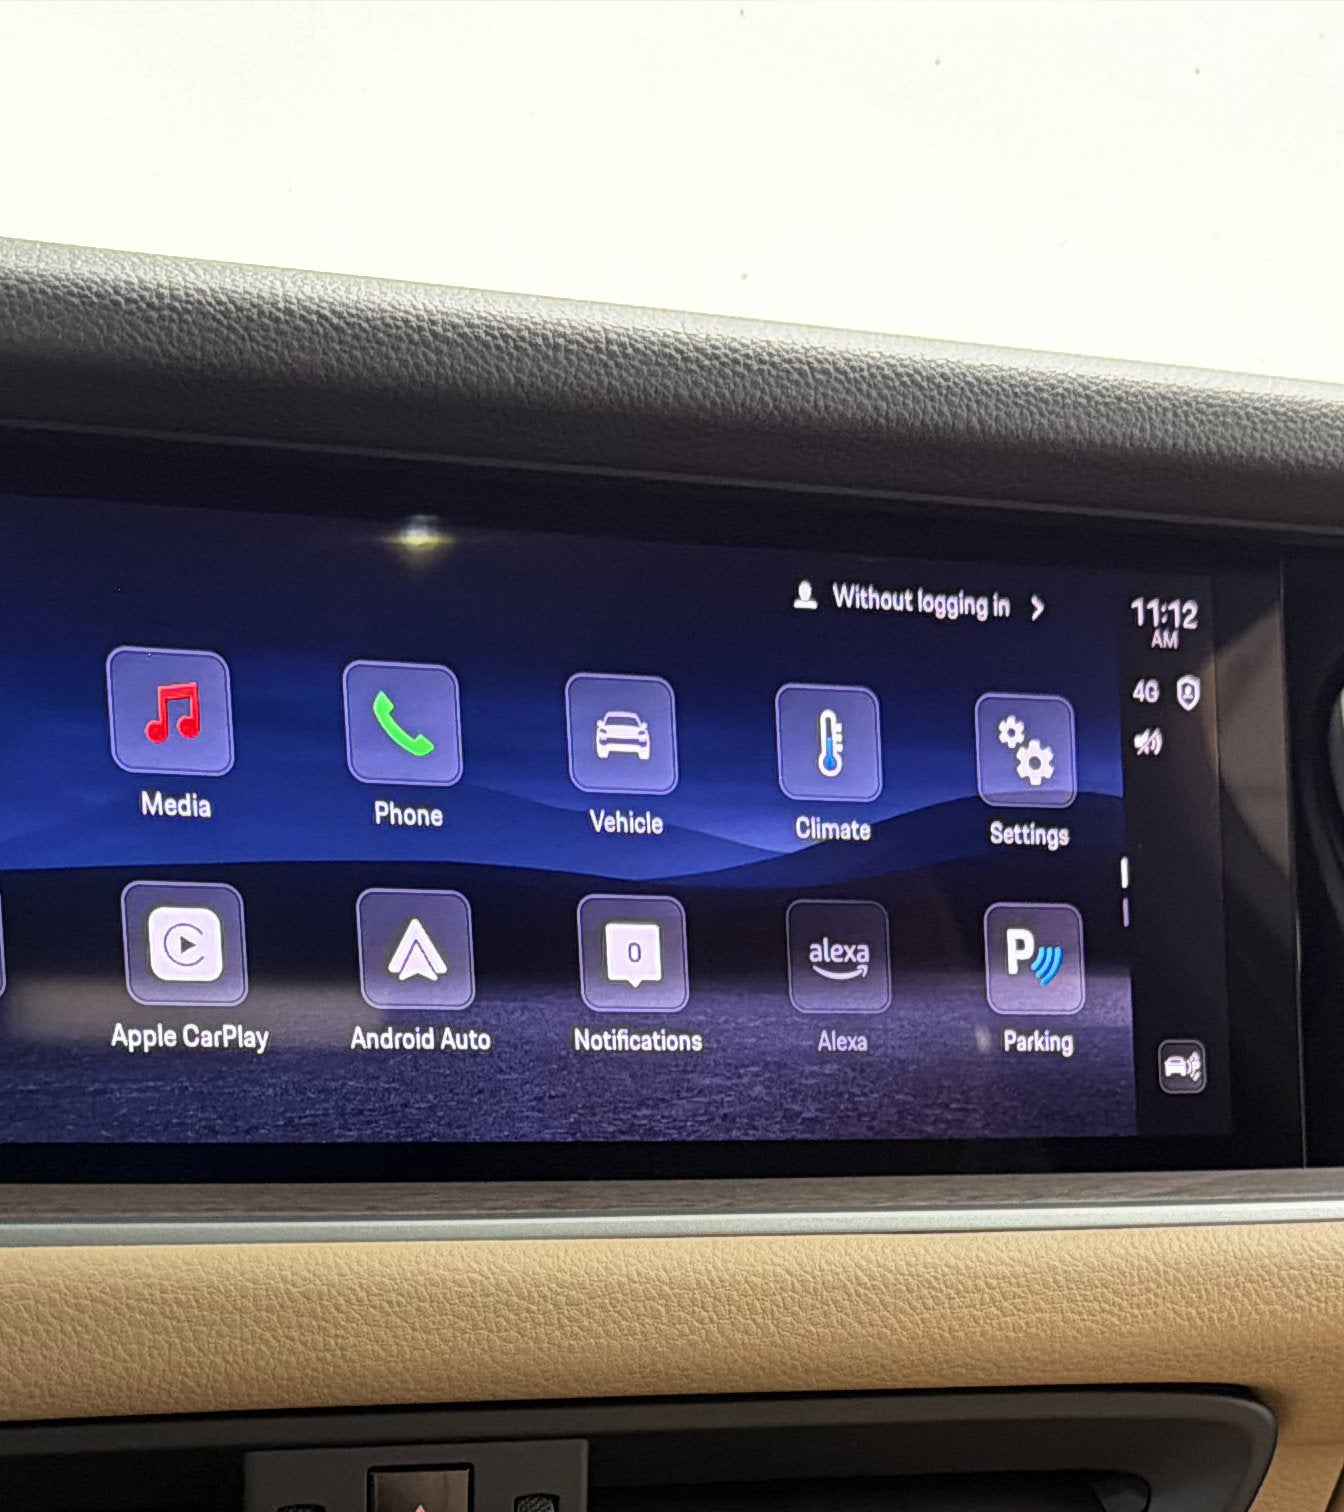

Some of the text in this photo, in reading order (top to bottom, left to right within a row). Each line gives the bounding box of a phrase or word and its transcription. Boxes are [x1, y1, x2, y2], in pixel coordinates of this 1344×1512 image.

[832, 582, 1011, 622] Without logging in
[1130, 597, 1199, 630] 11:12
[1151, 628, 1179, 650] AM
[1132, 679, 1160, 703] 4G
[141, 790, 212, 818] Media
[374, 800, 444, 829] Phone
[589, 808, 664, 836] Vehicle
[795, 815, 871, 842] Climate
[989, 820, 1071, 852] Settings
[628, 942, 642, 963] 0
[809, 936, 870, 964] alexa
[1005, 928, 1035, 976] P
[110, 1022, 270, 1055] Apple CarPlay
[350, 1025, 492, 1052] Android Auto
[574, 1027, 703, 1053] Notifications
[817, 1029, 869, 1053] Alexa
[1003, 1028, 1074, 1058] Parking
